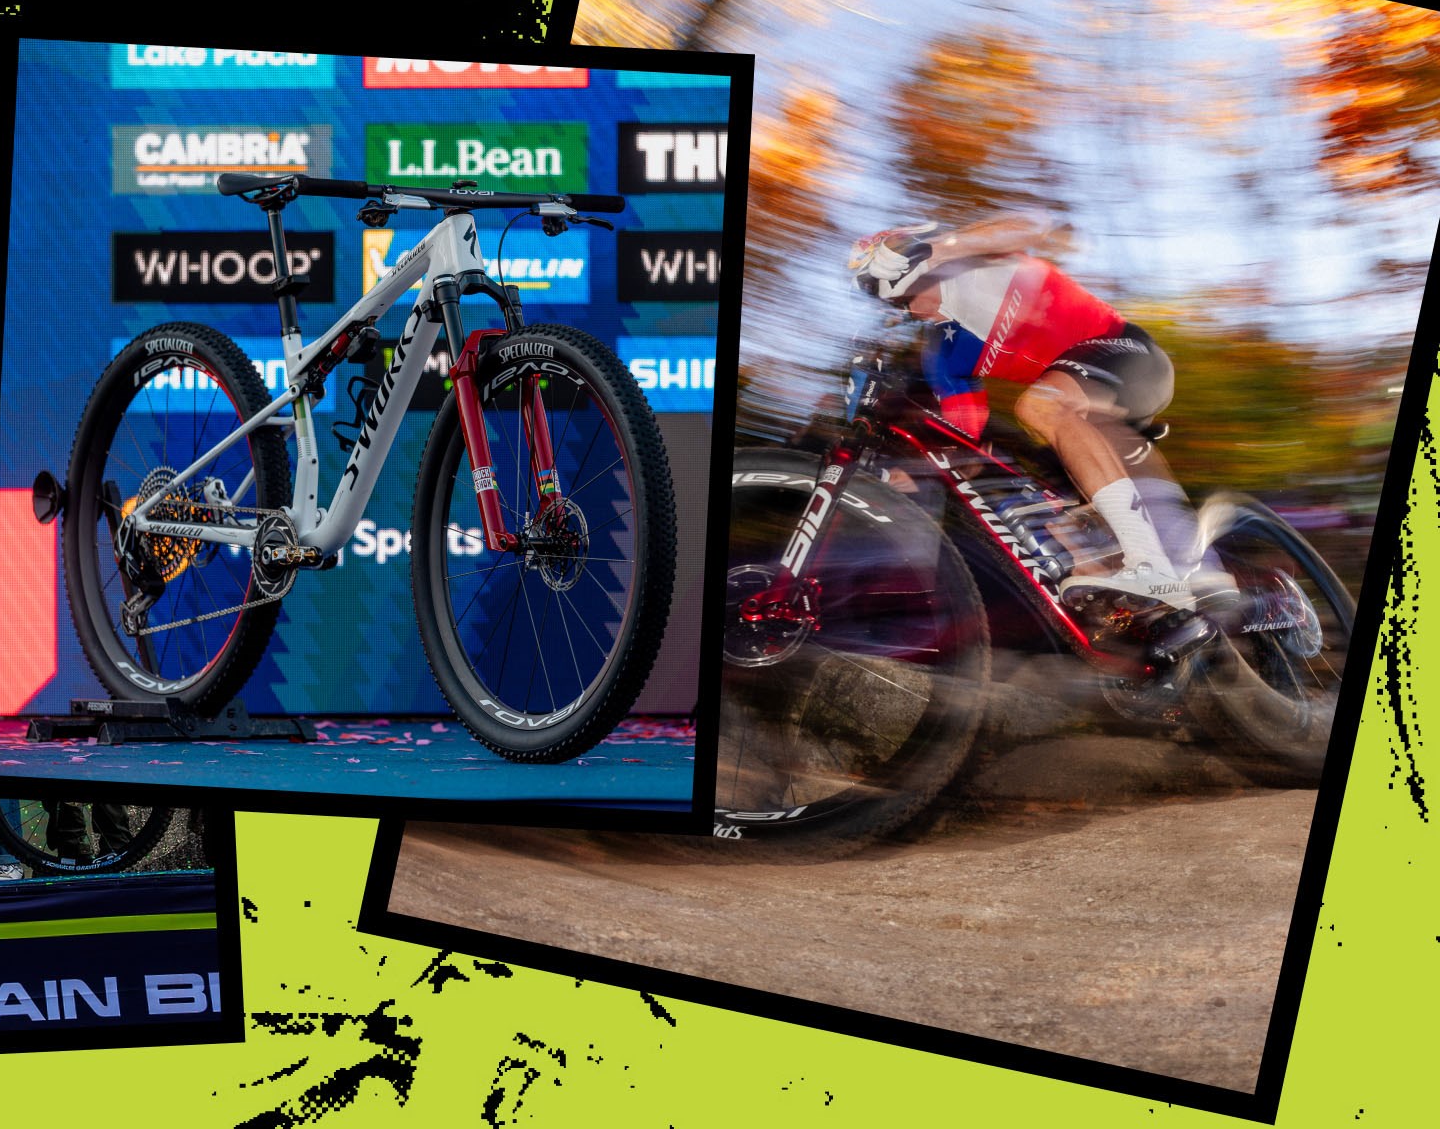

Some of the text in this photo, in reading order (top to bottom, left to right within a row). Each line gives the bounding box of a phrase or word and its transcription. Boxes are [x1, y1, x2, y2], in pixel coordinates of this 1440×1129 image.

[388, 139, 562, 176] L.L.Bean
[145, 337, 195, 354] SPECIALIZED
[498, 344, 554, 361] SPECIALIZED
[147, 522, 204, 537] SPECIALIZED
[780, 486, 833, 578] SID
[145, 972, 220, 1015] BI
